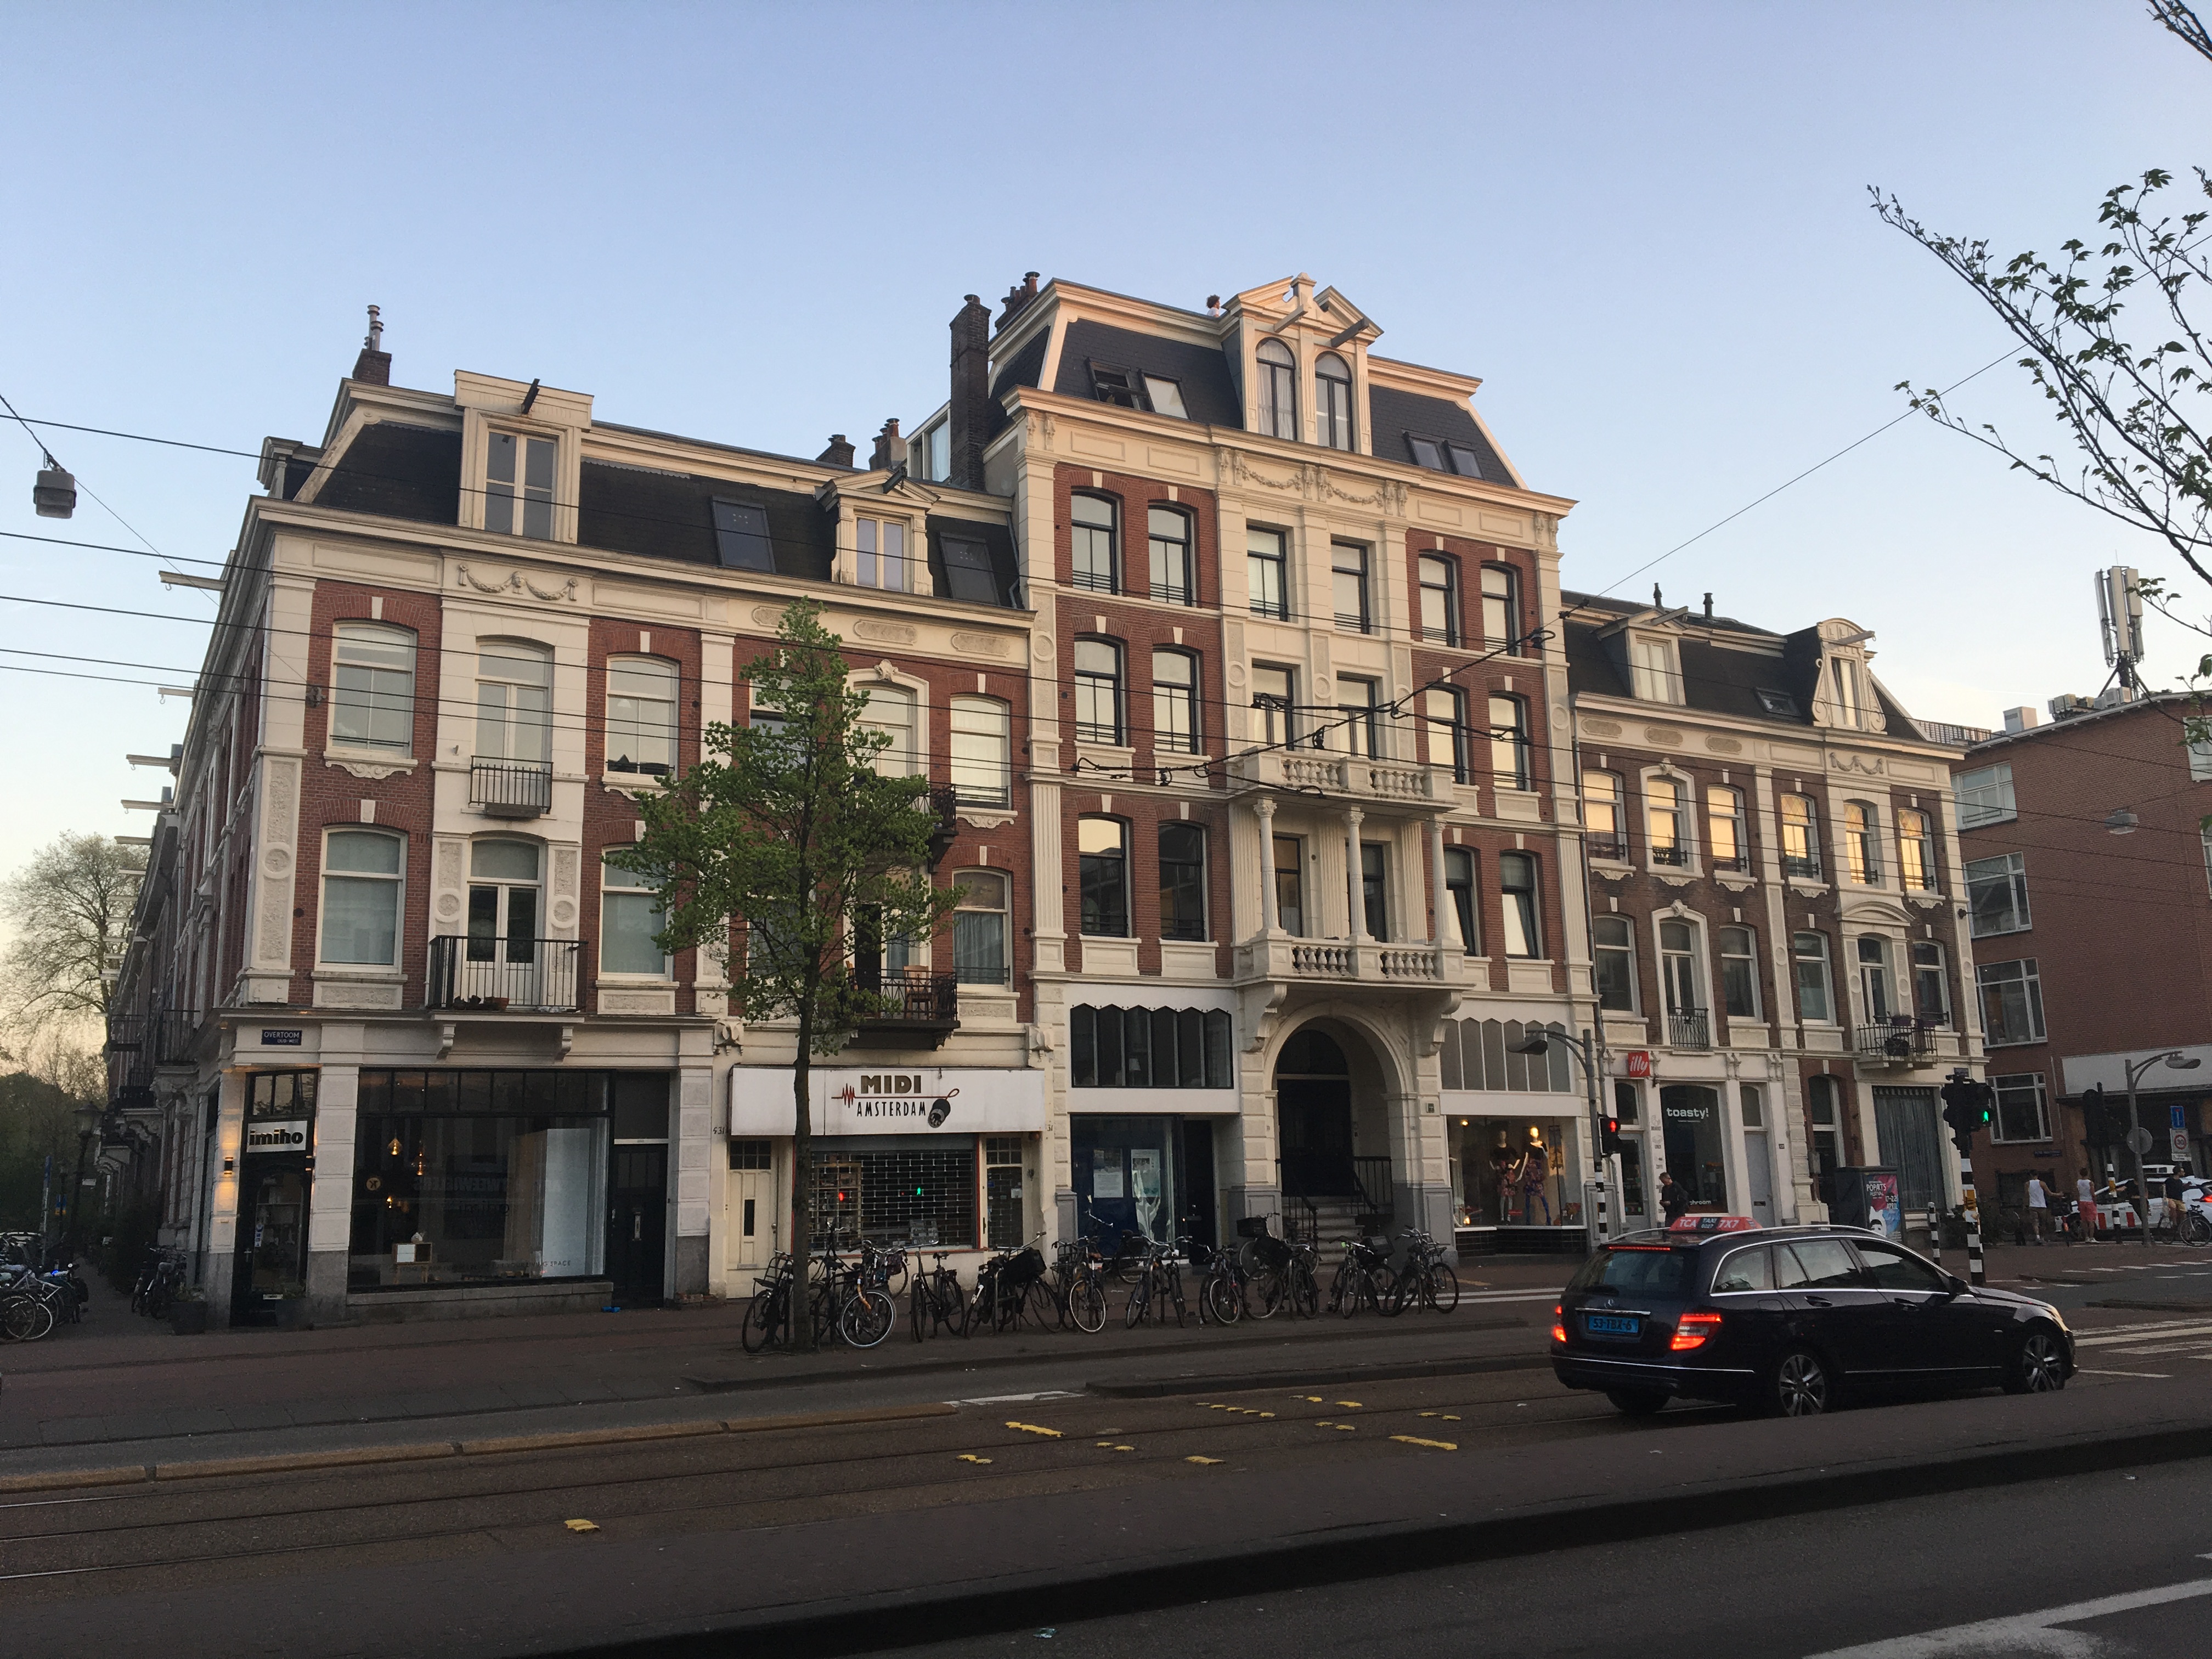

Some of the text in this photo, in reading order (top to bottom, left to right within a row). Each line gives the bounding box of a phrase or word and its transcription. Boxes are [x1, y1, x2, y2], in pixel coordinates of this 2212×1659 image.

[1630, 1055, 1648, 1075] illy
[861, 1075, 922, 1094] MIDI
[857, 1101, 926, 1116] AMSTERDAM
[1666, 1107, 1709, 1119] toasty!
[249, 1128, 304, 1146] imiho
[1679, 1219, 1696, 1227] TCA
